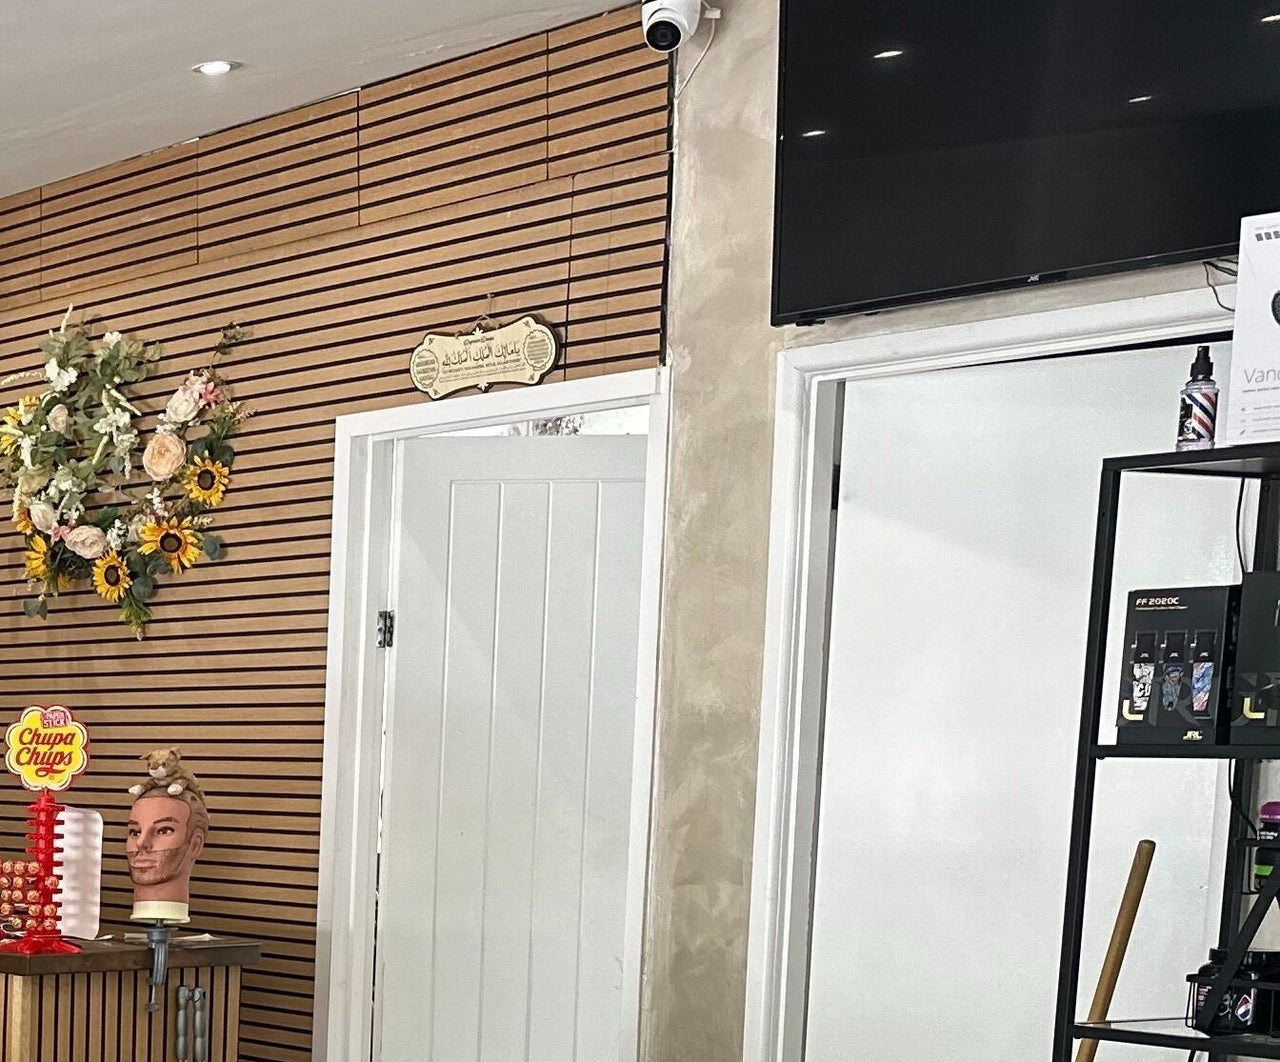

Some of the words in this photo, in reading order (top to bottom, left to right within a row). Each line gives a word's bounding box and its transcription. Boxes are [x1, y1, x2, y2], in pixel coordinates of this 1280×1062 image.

[43, 719, 66, 728] STICK
[18, 727, 76, 751] Chupa
[1182, 730, 1203, 741] JRL
[15, 747, 74, 777] Chups
